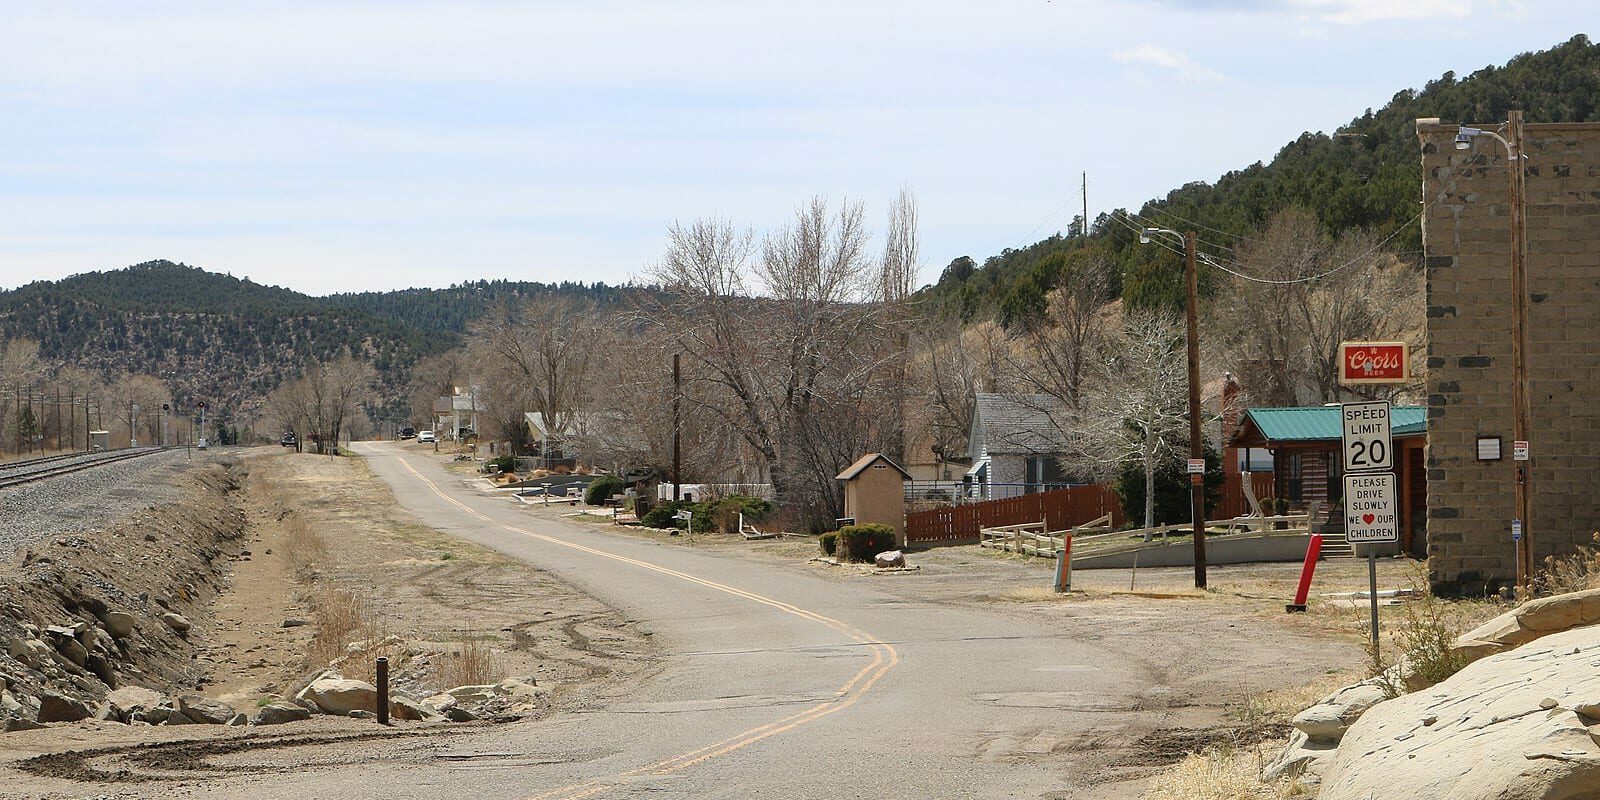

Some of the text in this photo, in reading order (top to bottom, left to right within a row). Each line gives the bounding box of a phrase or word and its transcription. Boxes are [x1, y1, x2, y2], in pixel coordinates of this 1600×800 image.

[1348, 350, 1399, 369] Coors
[1346, 409, 1386, 420] SPEED
[1351, 424, 1382, 434] LIMIT
[1351, 439, 1385, 465] 20
[1352, 478, 1387, 487] PLEASE
[1357, 490, 1383, 498] DRIVE
[1352, 501, 1387, 510] SLOWLY
[1349, 515, 1394, 524] WE OUR
[1350, 529, 1393, 537] CHILDREN
